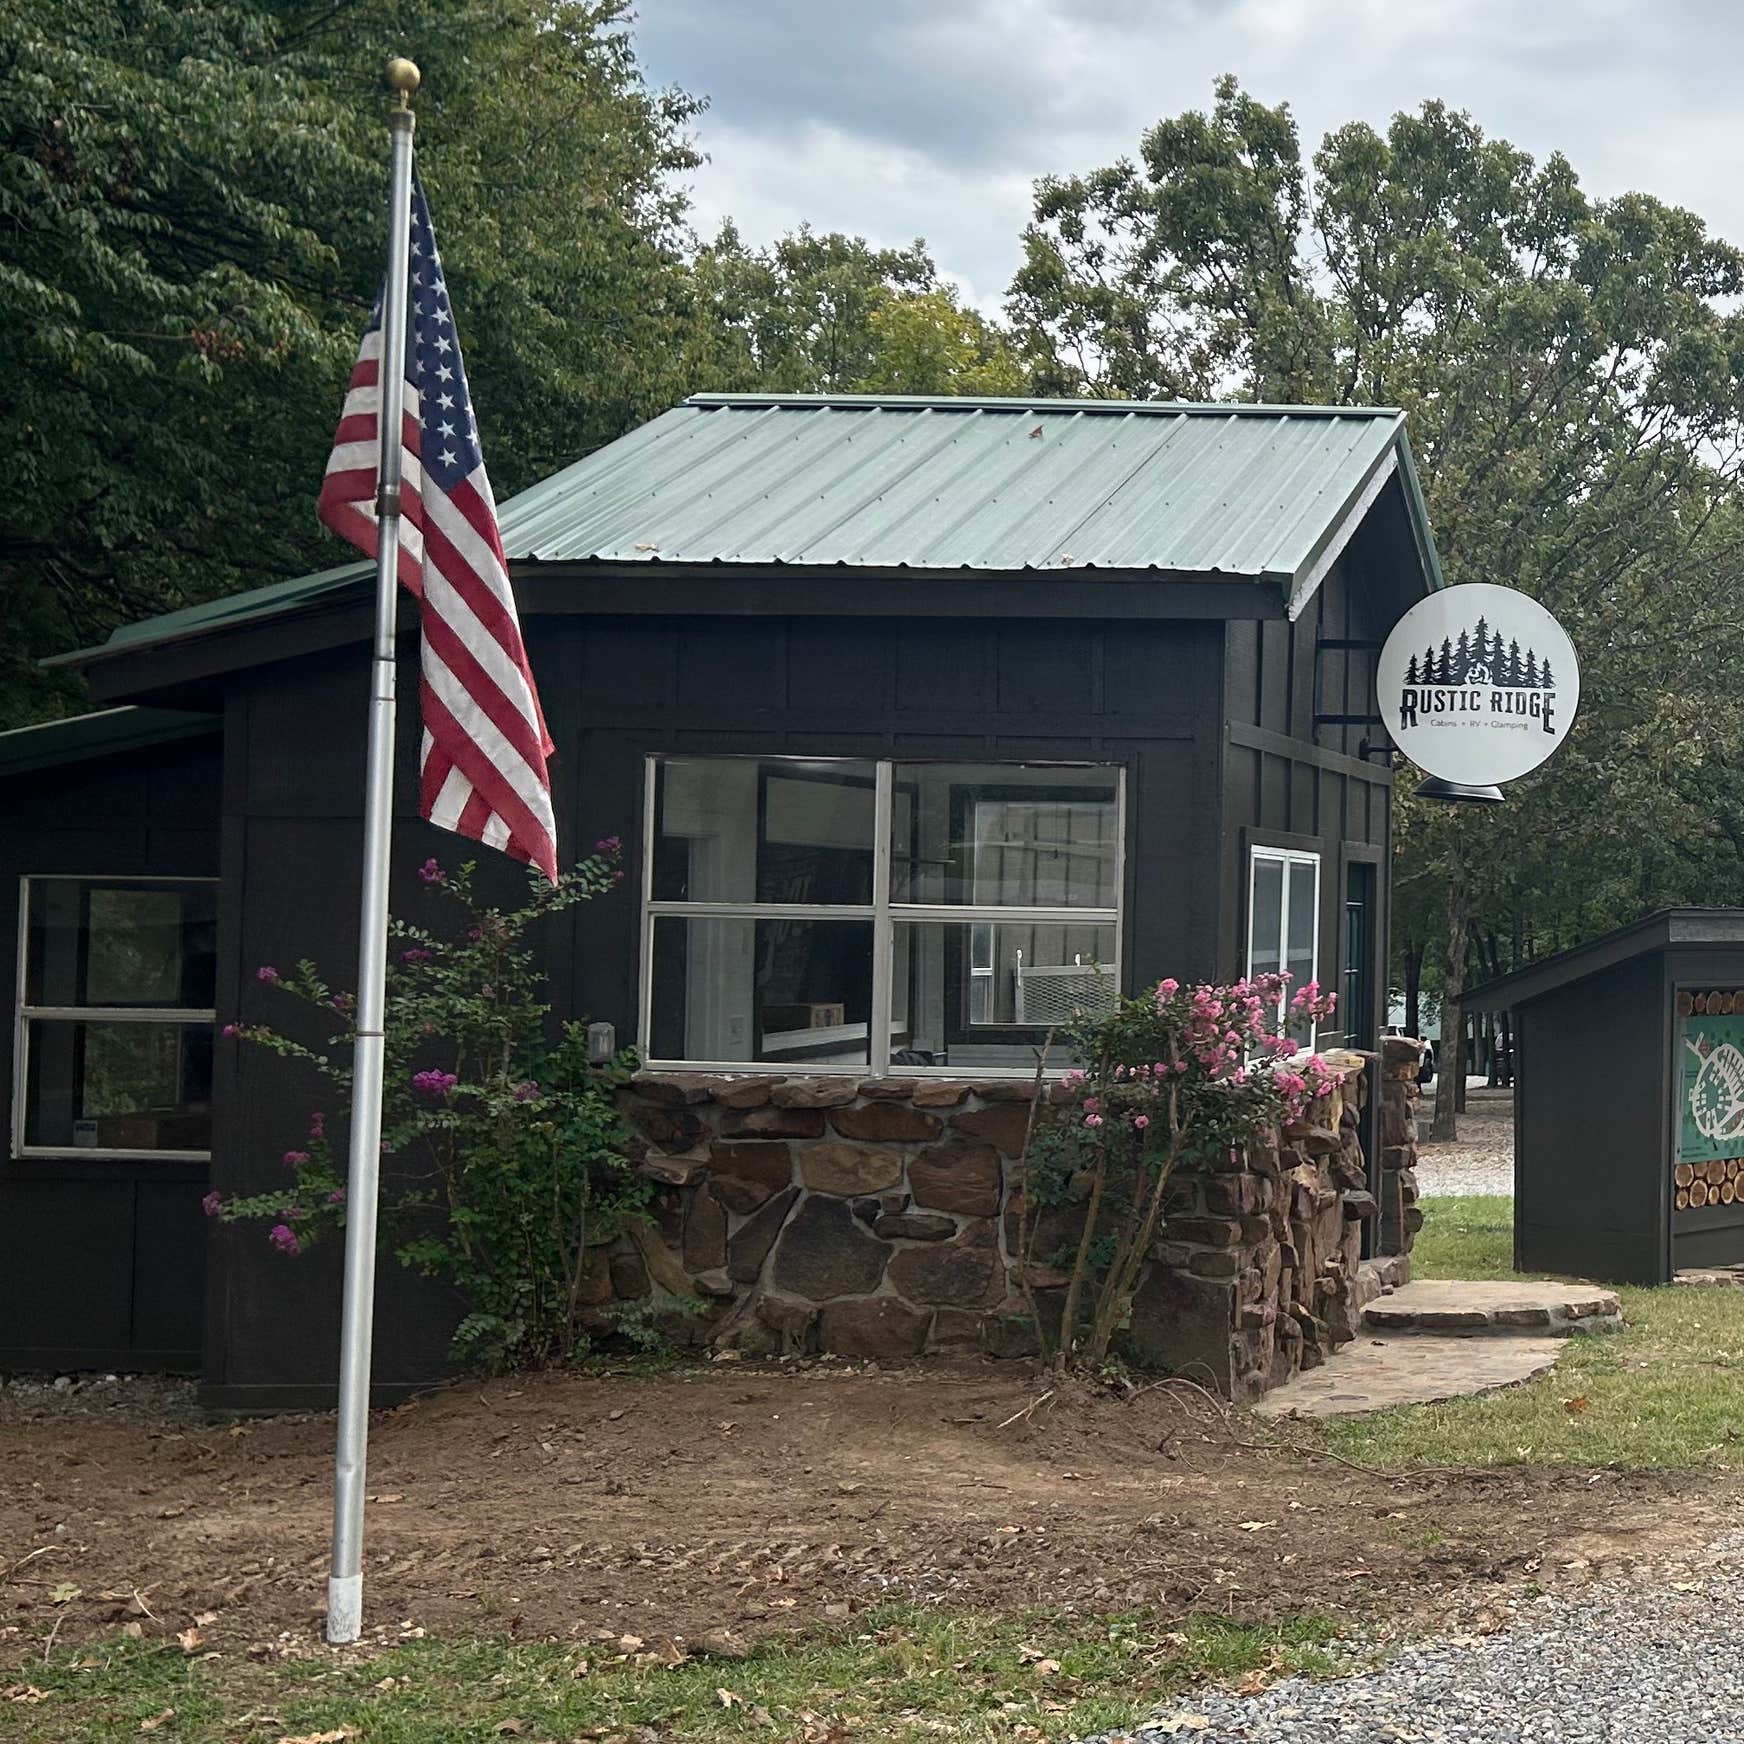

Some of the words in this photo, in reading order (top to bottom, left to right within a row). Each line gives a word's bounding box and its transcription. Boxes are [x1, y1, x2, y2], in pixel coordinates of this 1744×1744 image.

[1400, 688, 1481, 730] RUSTIC
[1490, 690, 1556, 735] RIDGE
[1430, 718, 1457, 728] Cabins
[1469, 719, 1481, 728] RV
[1490, 720, 1529, 731] Glamping
